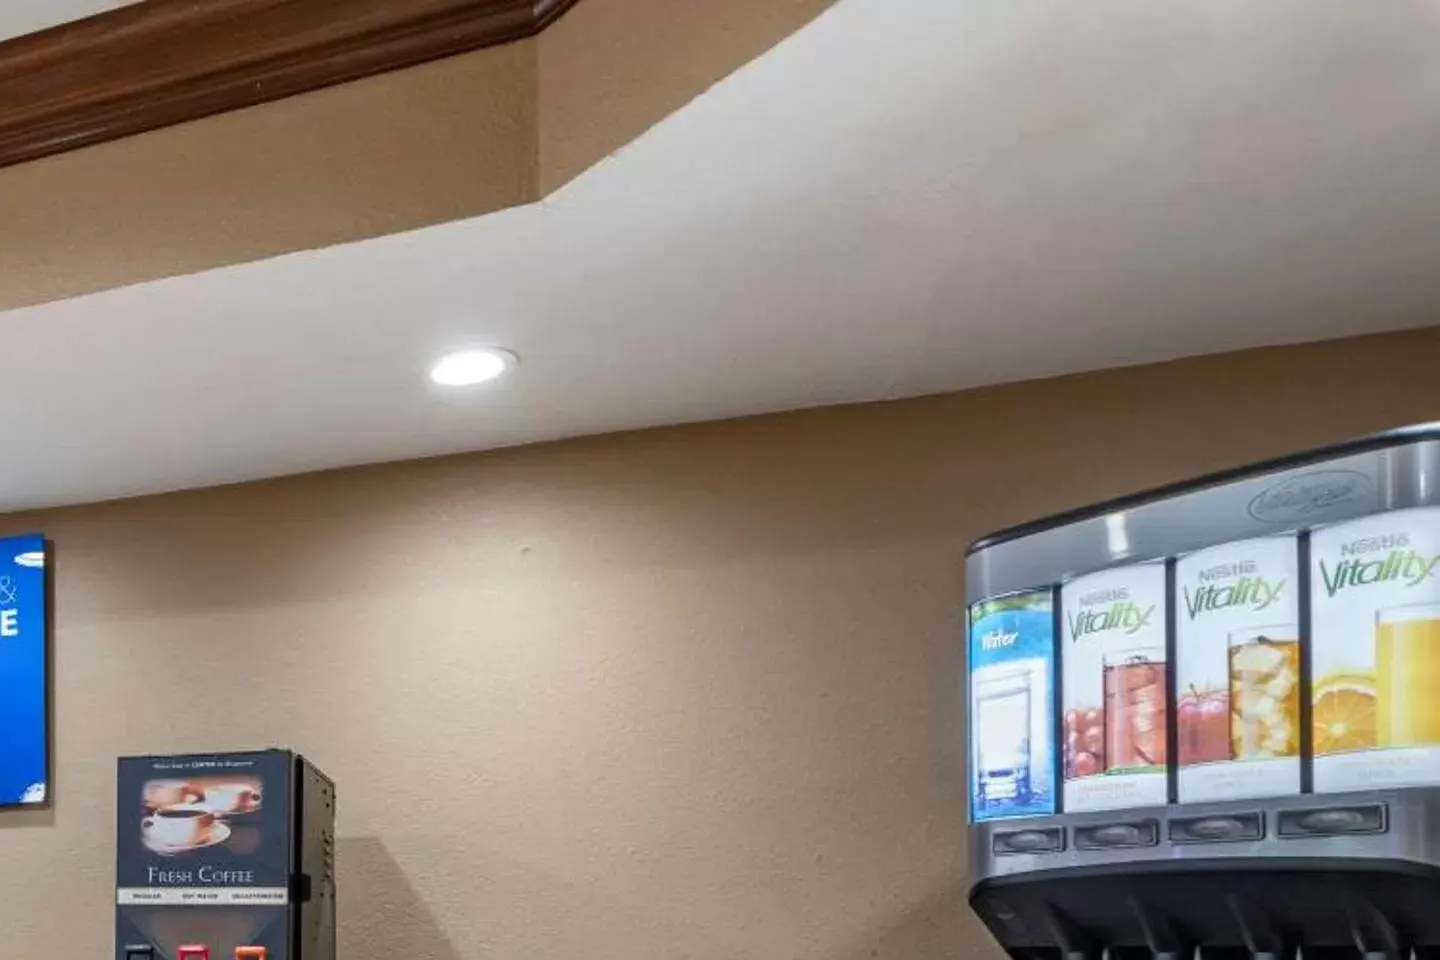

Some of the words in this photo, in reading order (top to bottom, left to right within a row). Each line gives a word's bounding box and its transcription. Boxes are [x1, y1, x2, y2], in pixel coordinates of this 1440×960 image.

[1320, 549, 1440, 598] Vitality
[1183, 576, 1288, 621] Vitality
[1067, 602, 1157, 643] Vitality
